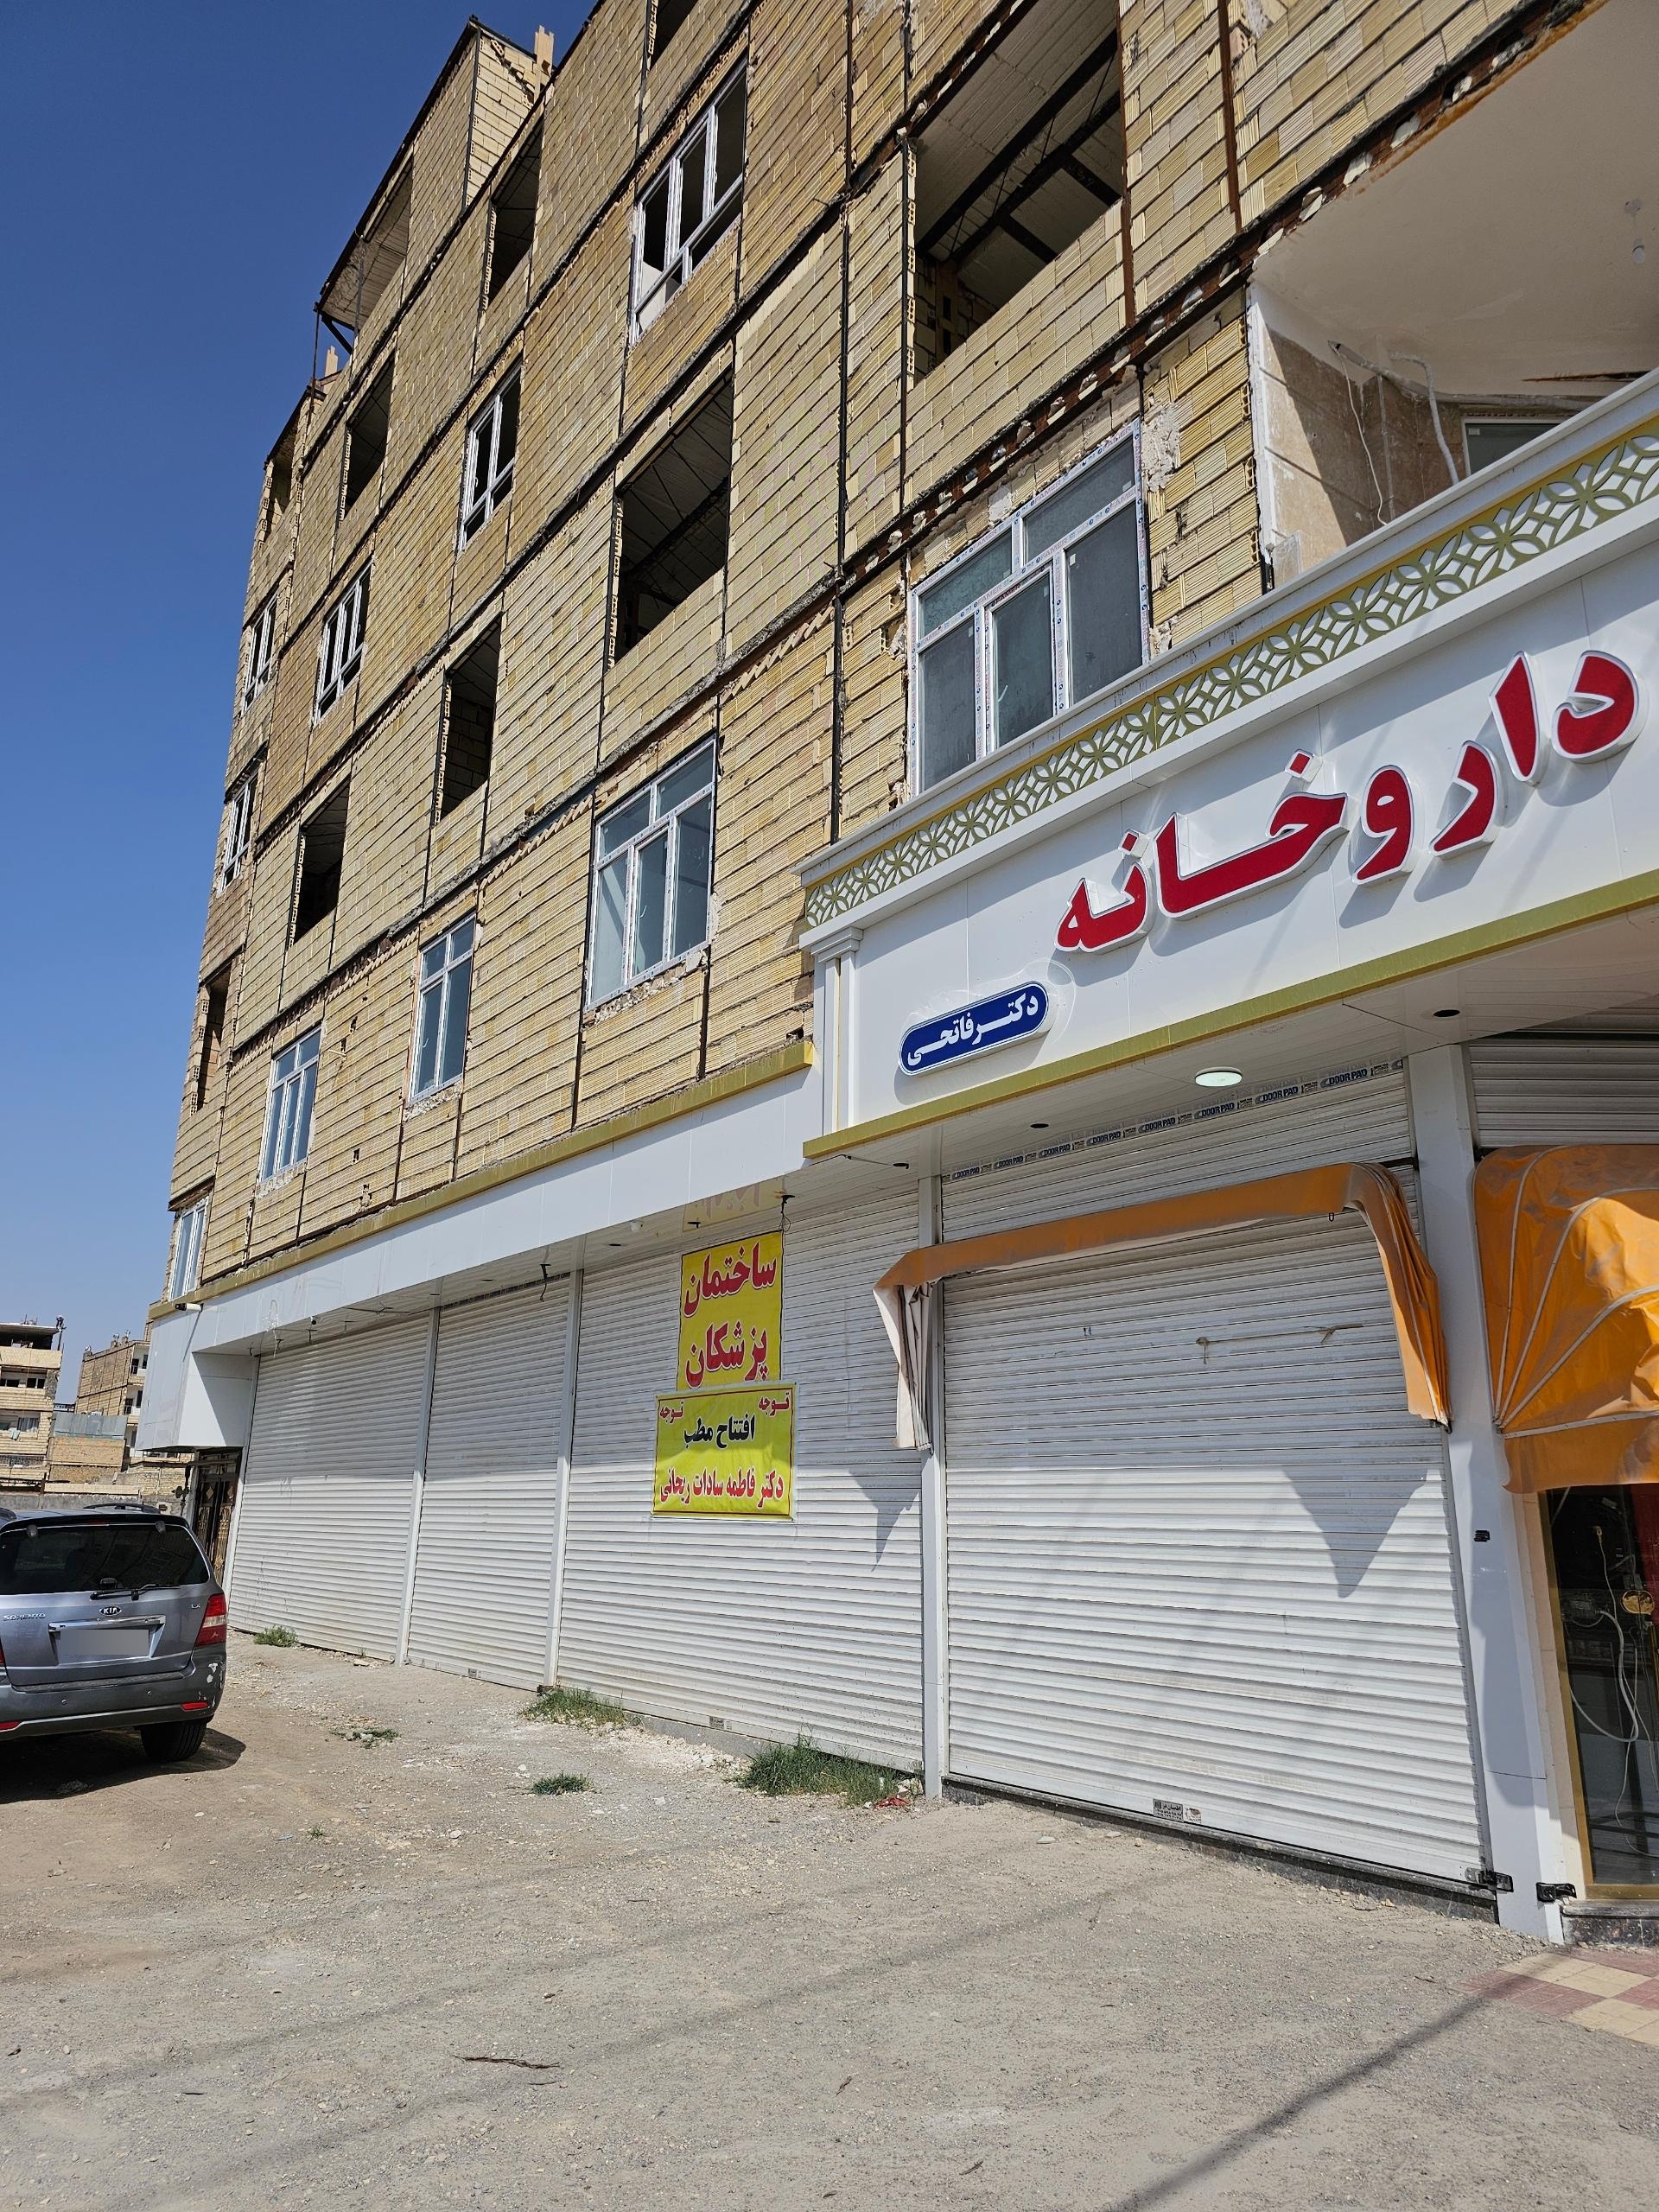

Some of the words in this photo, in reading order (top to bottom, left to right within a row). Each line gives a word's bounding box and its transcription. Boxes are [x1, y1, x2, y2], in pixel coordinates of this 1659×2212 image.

[1055, 651, 1640, 953] داروخانه
[971, 993, 1039, 1046] دکتر
[907, 1012, 975, 1066] فاتحی
[683, 1241, 777, 1317] ساختمان
[685, 1321, 768, 1389] پزشکان
[659, 1401, 683, 1424] توجه
[758, 1392, 790, 1416] توجه
[684, 1417, 714, 1449] مطب
[716, 1413, 755, 1448] افتتاح
[660, 1468, 690, 1504] ریحانی
[692, 1468, 723, 1497] سادات
[726, 1466, 756, 1498] فاطمه
[757, 1469, 784, 1508] دکتر
[3, 1612, 46, 1621] SORENTO
